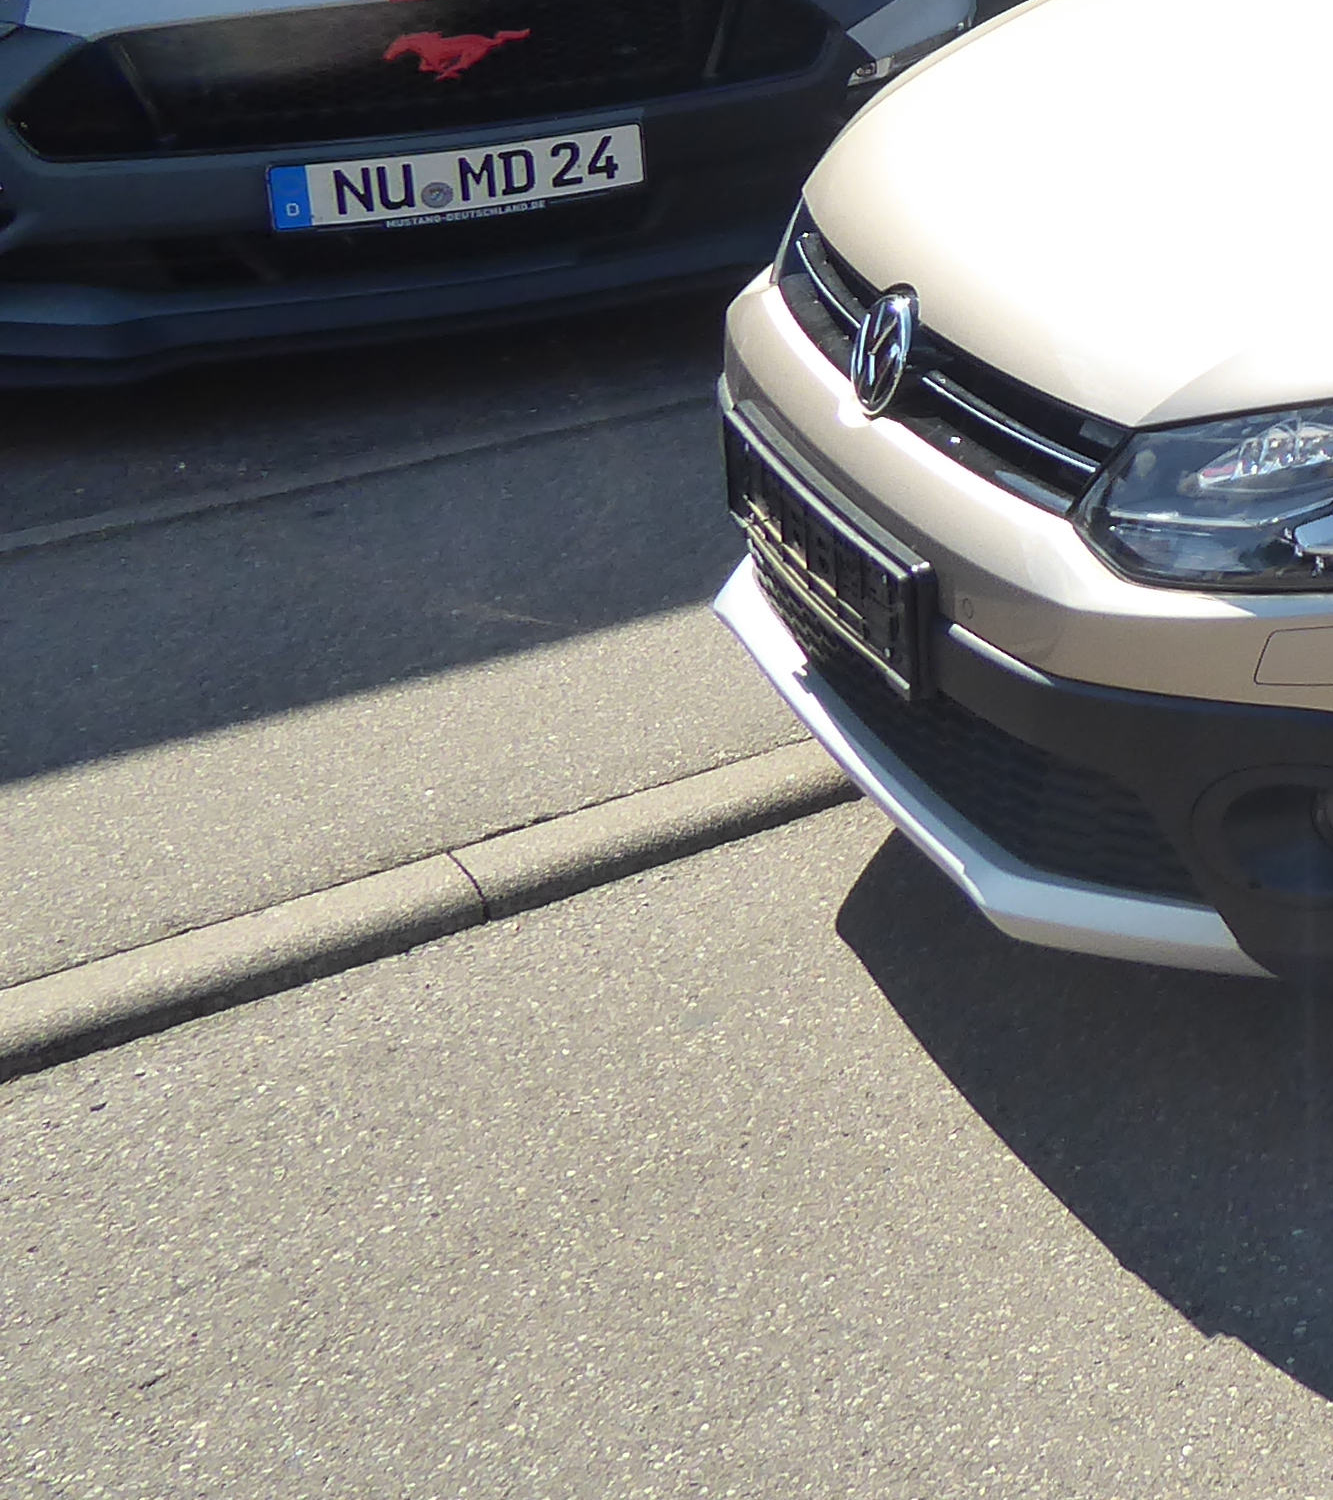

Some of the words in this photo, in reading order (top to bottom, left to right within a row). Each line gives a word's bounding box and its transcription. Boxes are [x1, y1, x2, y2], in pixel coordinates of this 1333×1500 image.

[333, 163, 416, 216] NU
[457, 148, 536, 202] MD
[550, 135, 619, 190] 24
[386, 200, 546, 228] MUSTANG-DEUTSCHLAND.DE
